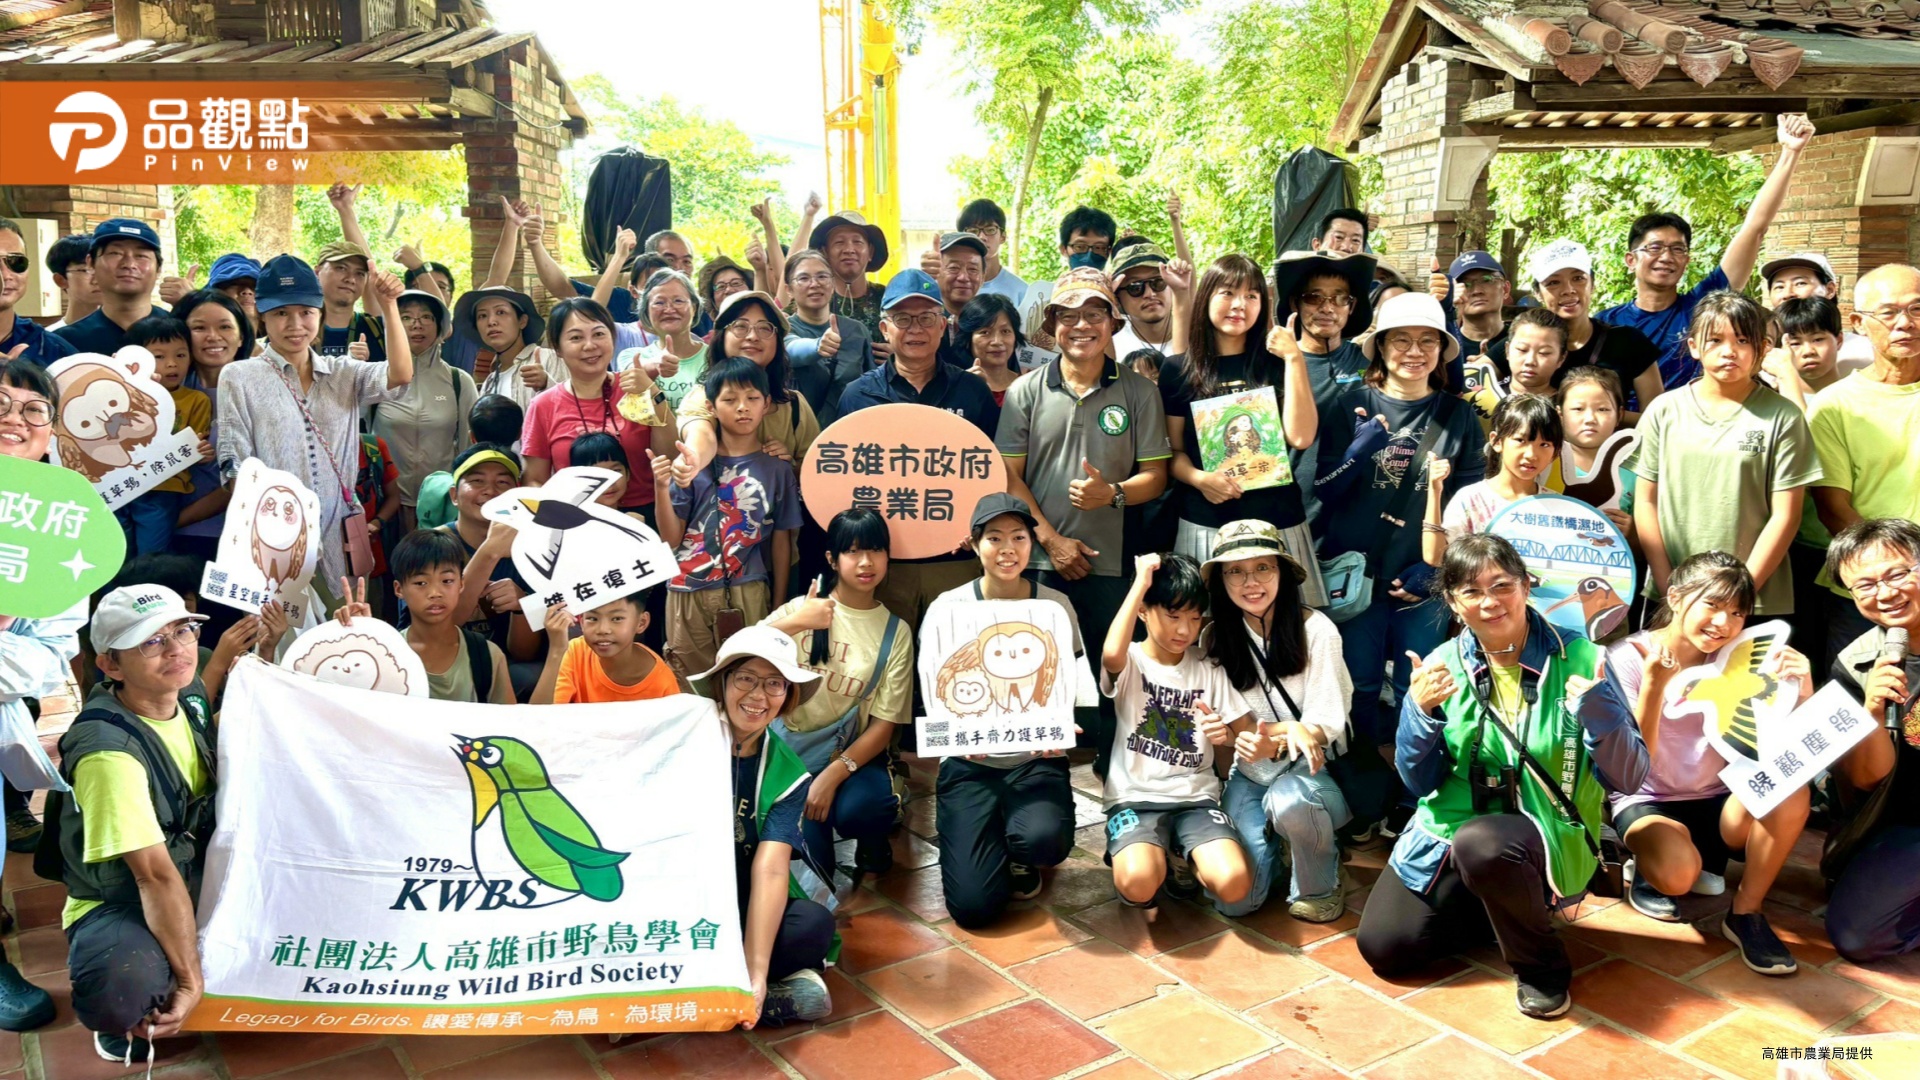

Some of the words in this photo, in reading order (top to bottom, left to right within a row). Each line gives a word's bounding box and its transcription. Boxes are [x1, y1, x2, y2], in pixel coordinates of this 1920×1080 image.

[816, 441, 993, 480] 高雄市政府
[1385, 445, 1416, 456] Ultima
[0, 490, 91, 540] 政府
[851, 485, 954, 522] 農業局
[131, 593, 163, 609] eBird
[954, 726, 1065, 747] 攜手齊力護草鴞
[1126, 732, 1181, 766] ADVENTURE
[388, 877, 543, 912] KWBS
[269, 918, 721, 972] 社團法人高雄市野鳥學會
[301, 975, 450, 1001] Kaohsiung
[457, 975, 520, 996] Wild
[526, 966, 583, 992] Bird
[590, 960, 685, 984] Society
[219, 1007, 308, 1028] Legacy
[311, 1012, 347, 1026] for
[349, 1013, 413, 1028] Birds.
